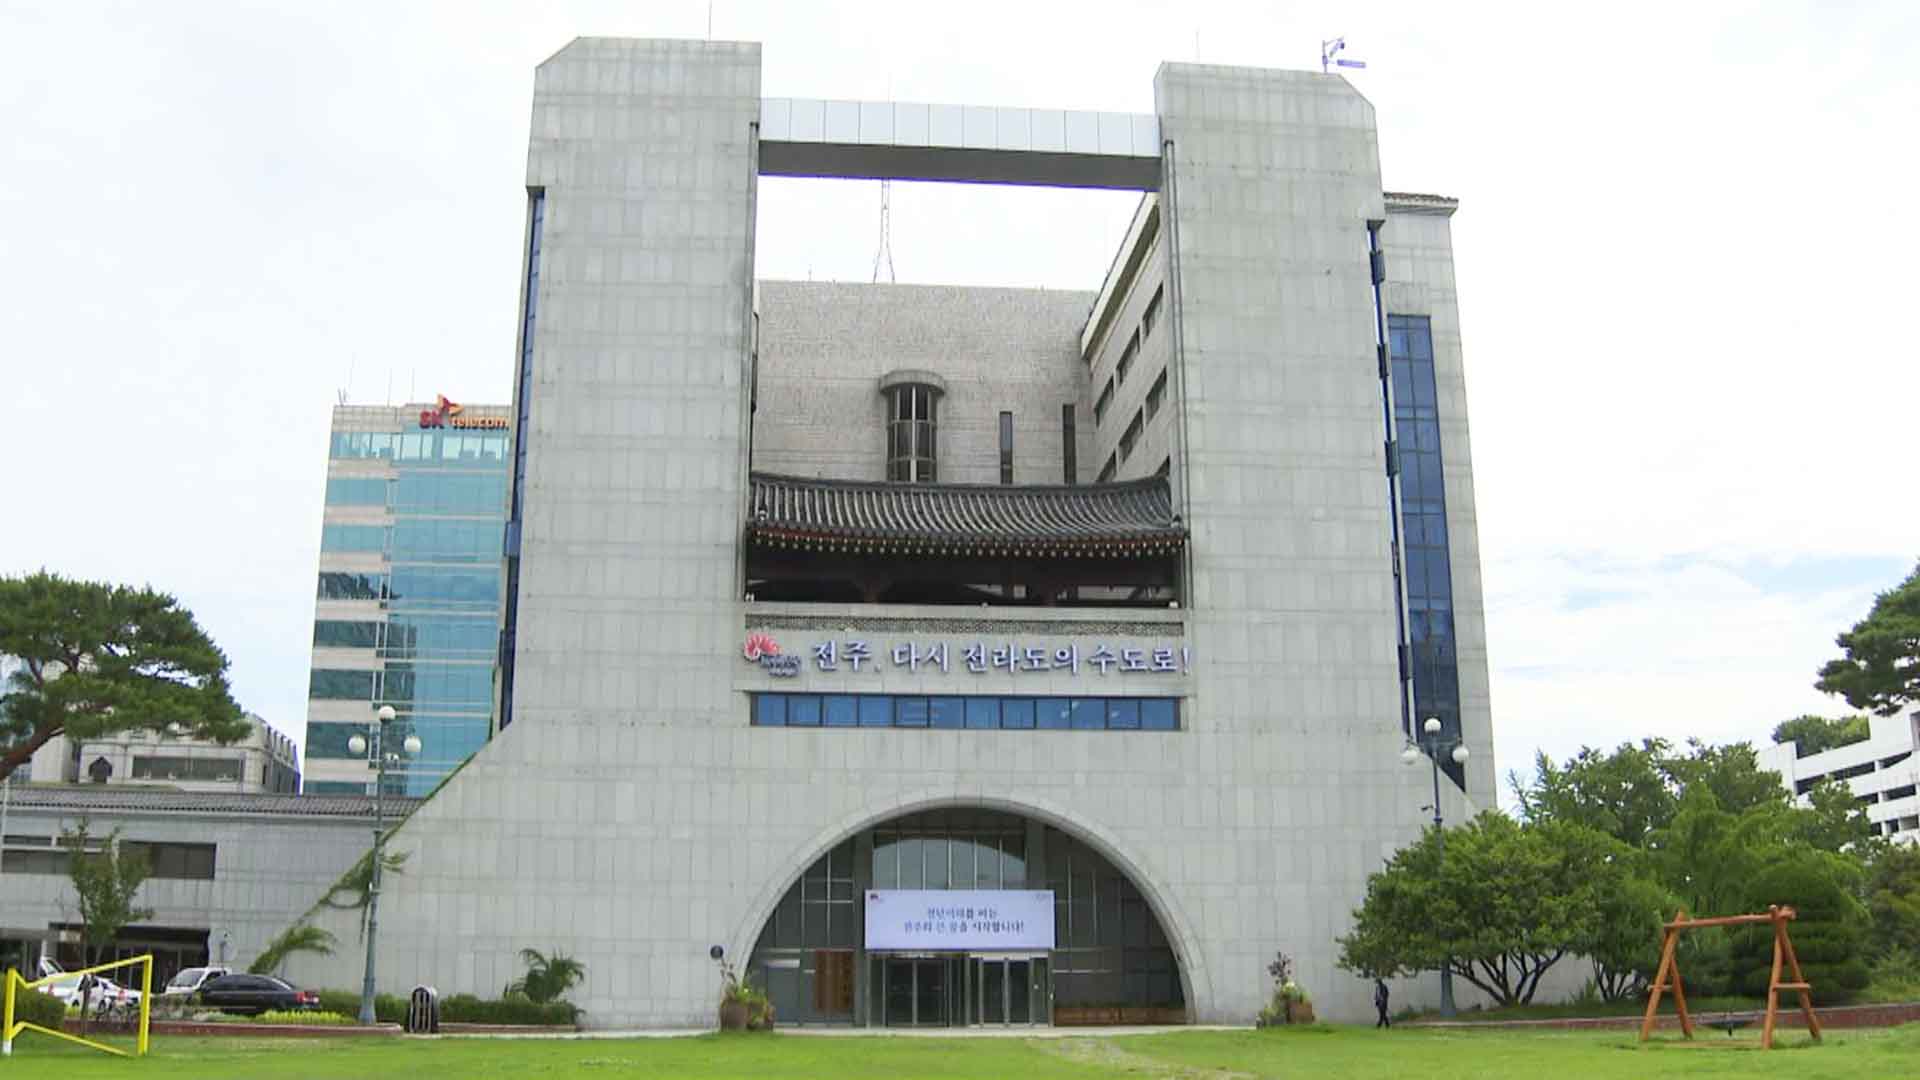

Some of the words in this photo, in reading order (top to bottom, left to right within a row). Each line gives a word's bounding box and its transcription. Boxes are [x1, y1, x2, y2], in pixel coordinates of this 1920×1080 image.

[419, 407, 444, 429] SK
[891, 639, 949, 673] 다시
[963, 641, 1079, 675] 전라도의
[1088, 643, 1192, 676] 수도로!
